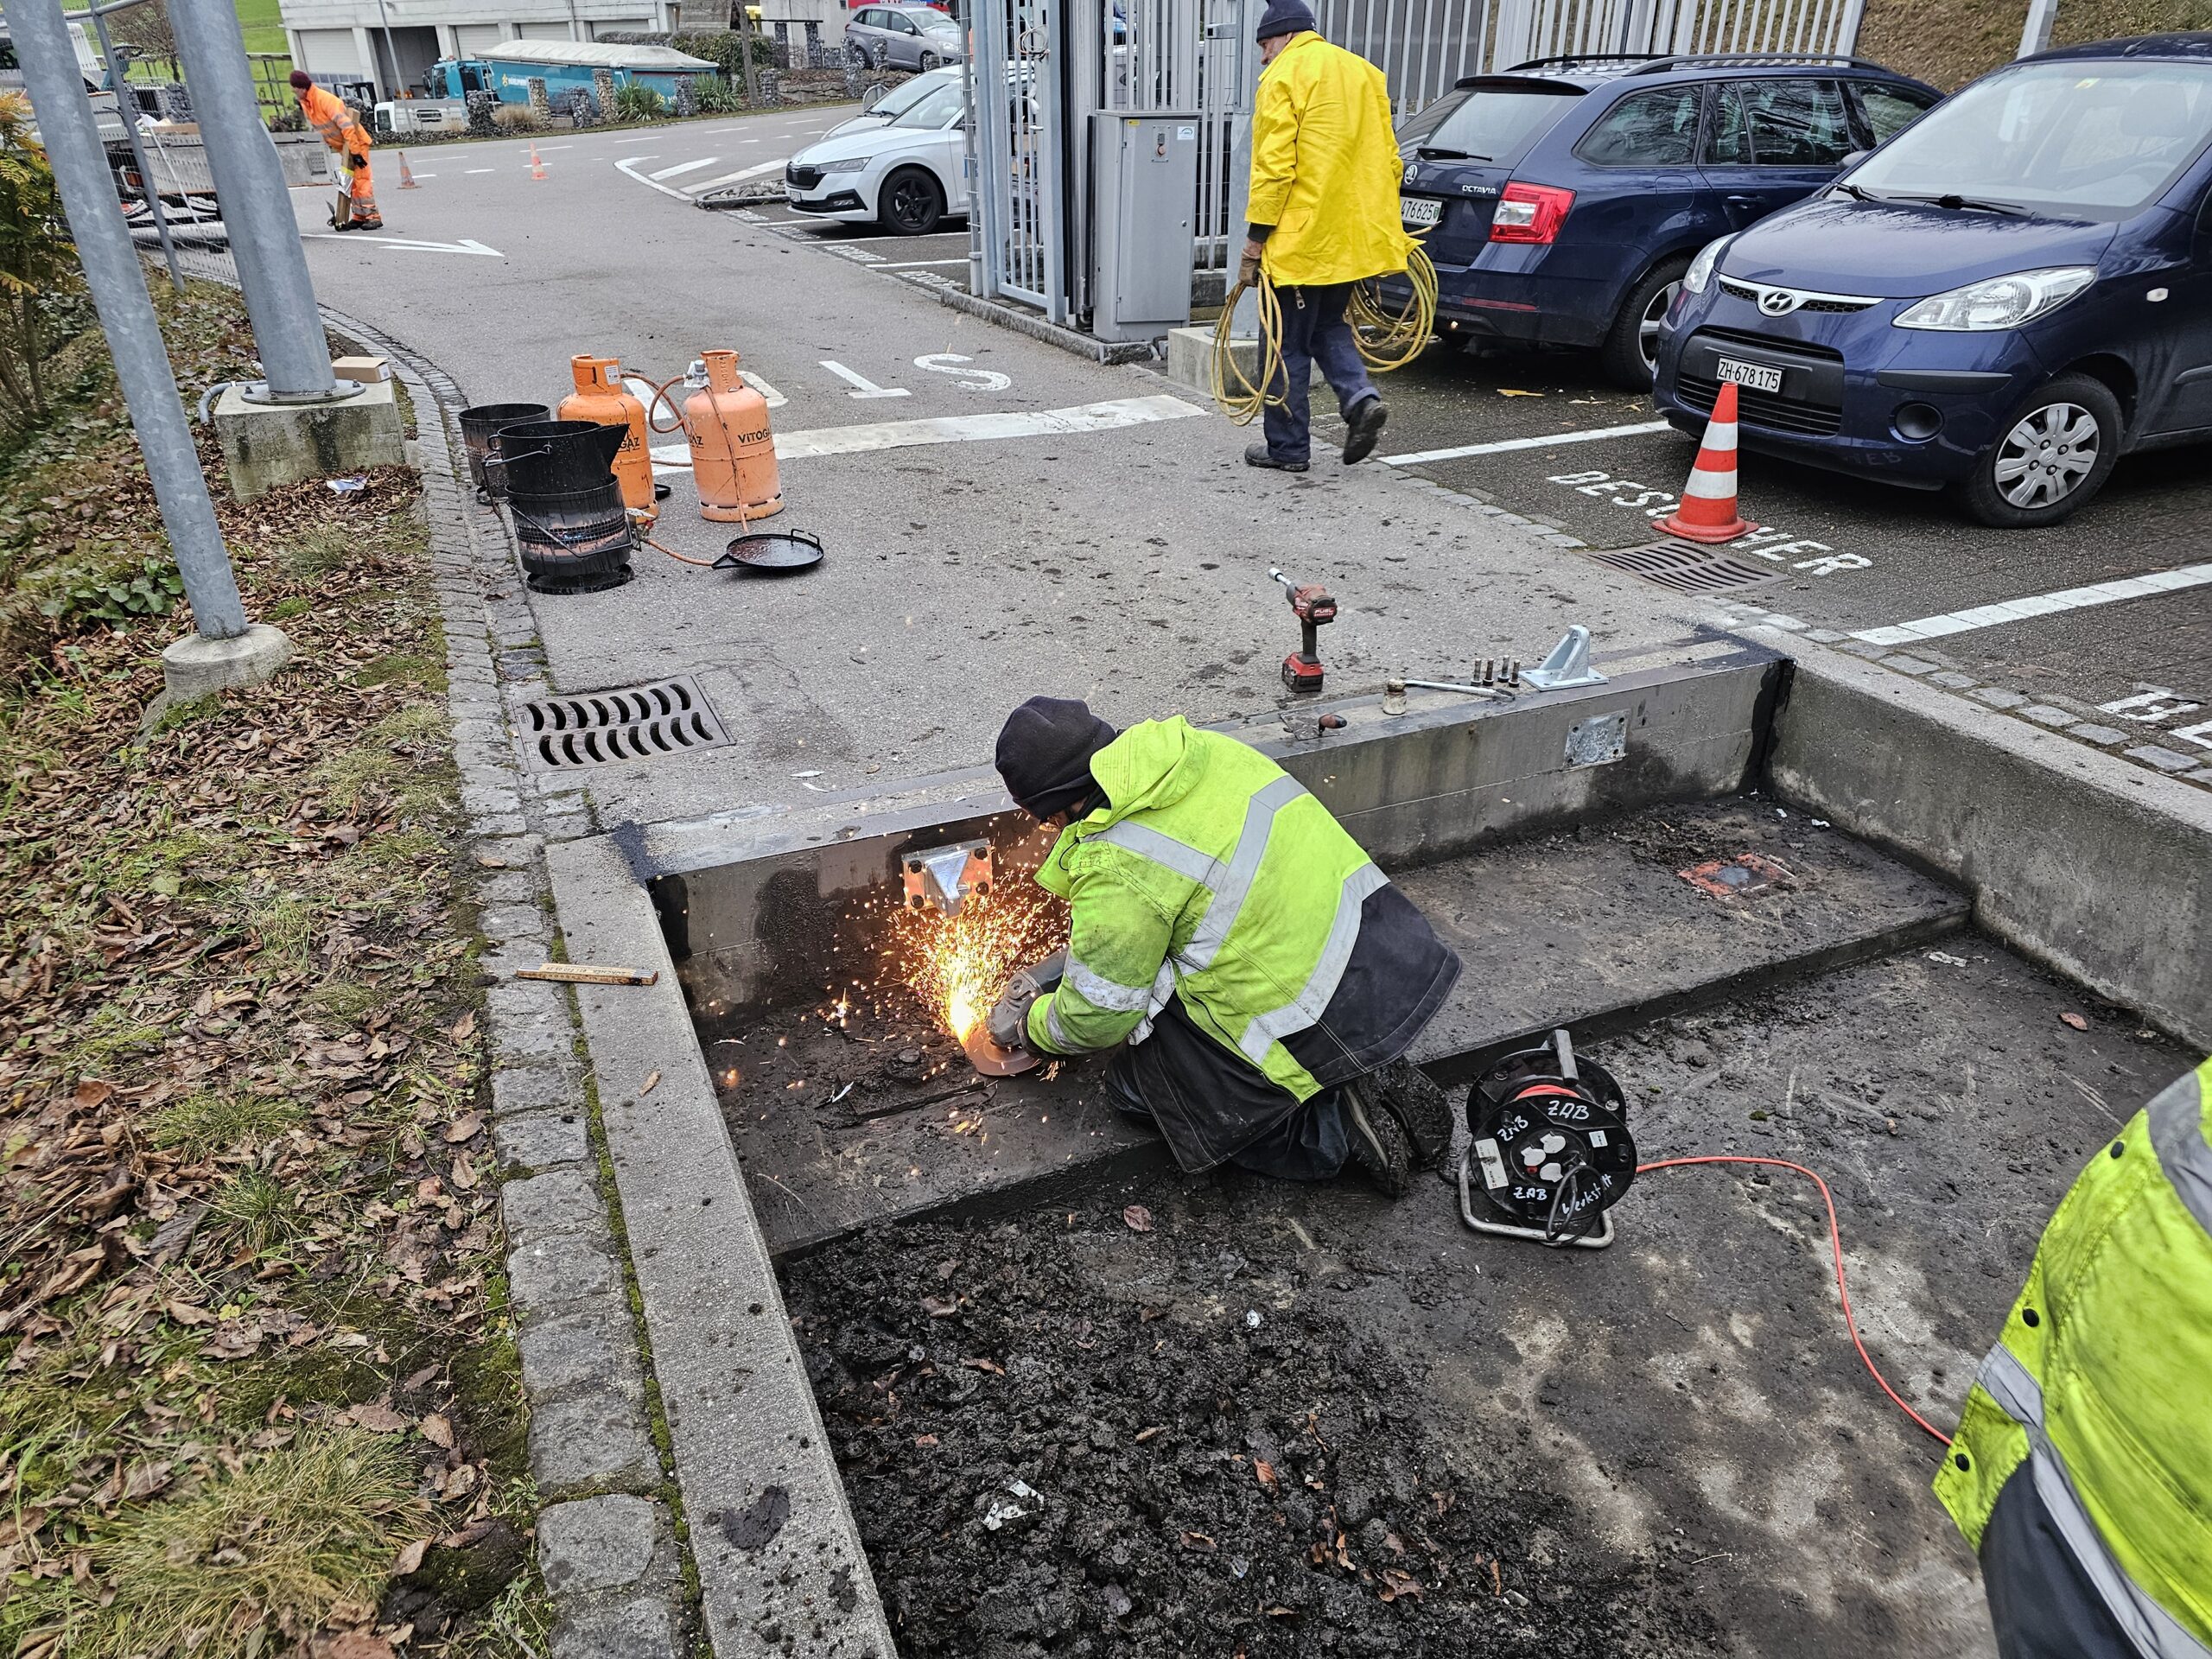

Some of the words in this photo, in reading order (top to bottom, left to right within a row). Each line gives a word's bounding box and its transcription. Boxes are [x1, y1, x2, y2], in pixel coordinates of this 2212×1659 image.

[1462, 185, 1497, 194] OCTAVIA
[1548, 1100, 1590, 1120] ZAB
[1513, 1186, 1548, 1200] ZAB
